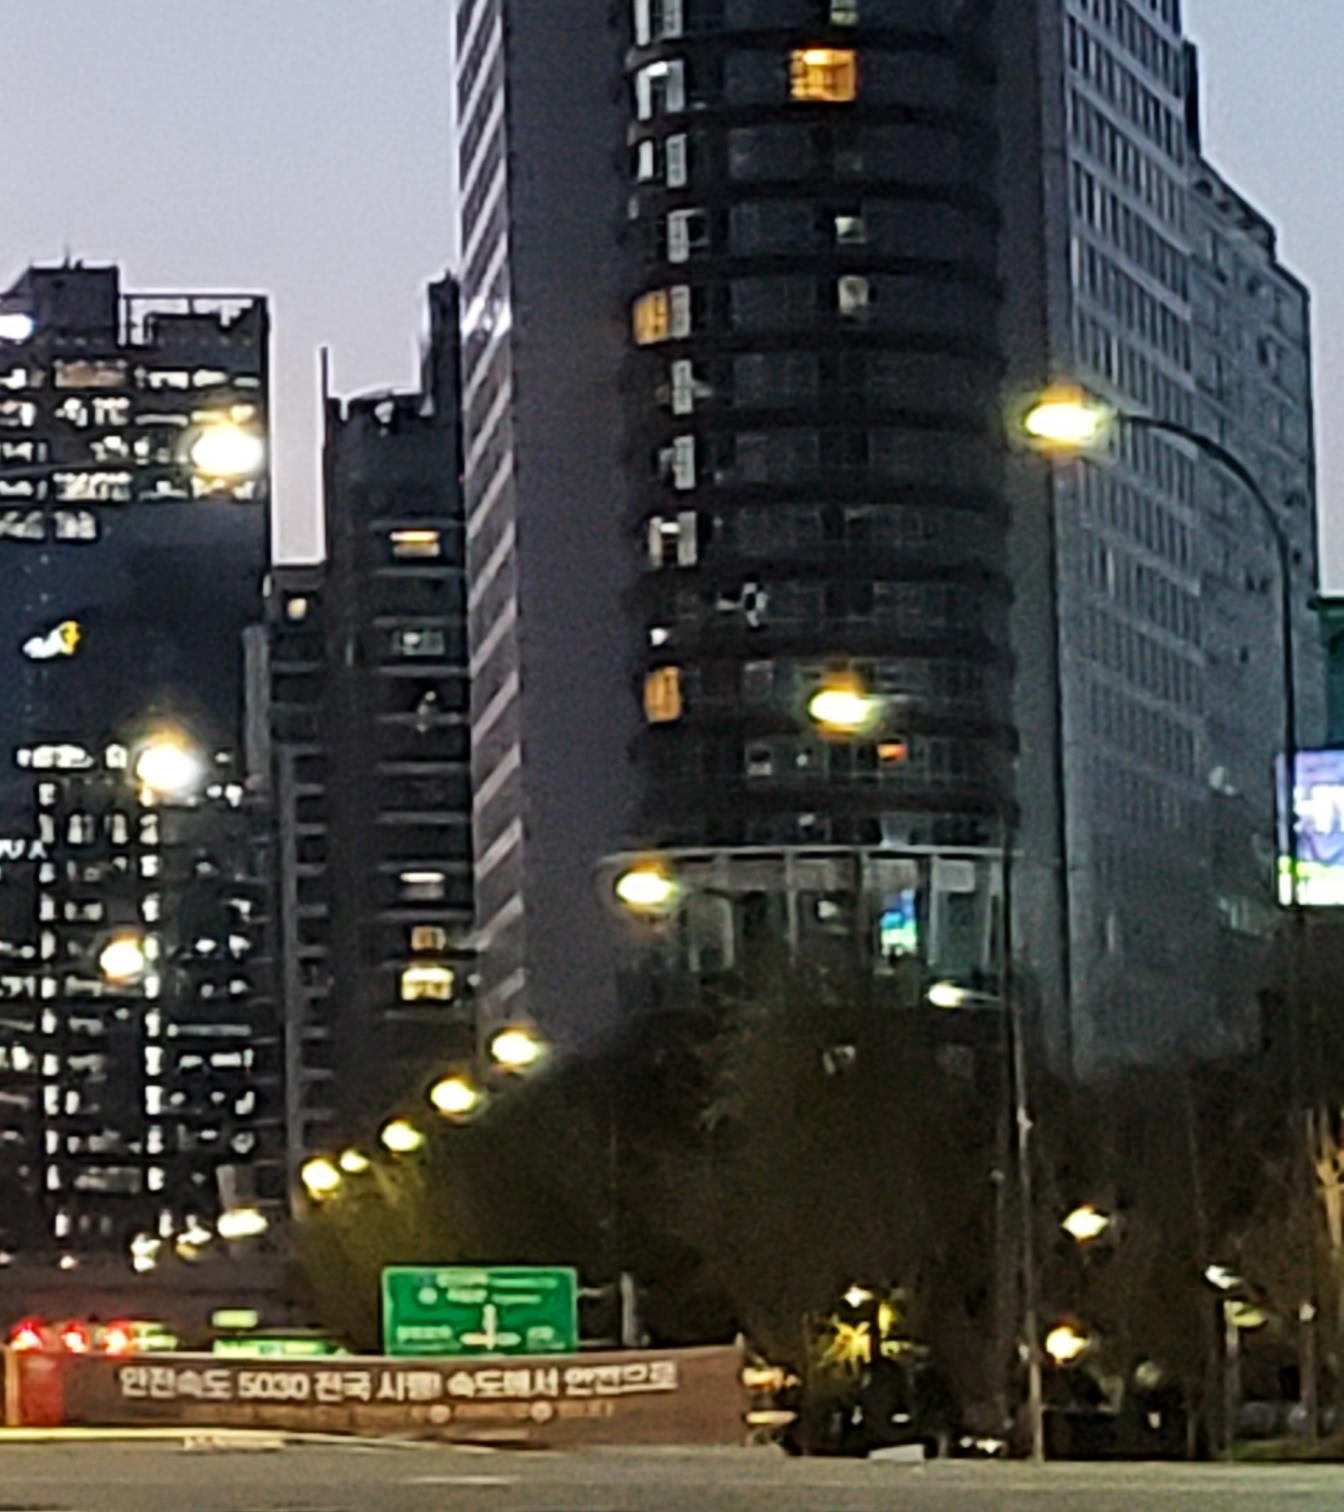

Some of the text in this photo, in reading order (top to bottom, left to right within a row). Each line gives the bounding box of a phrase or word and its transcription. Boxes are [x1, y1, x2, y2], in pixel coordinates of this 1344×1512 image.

[119, 1366, 232, 1399] 안전속도
[237, 1371, 310, 1400] 5030
[315, 1371, 371, 1402] 전국
